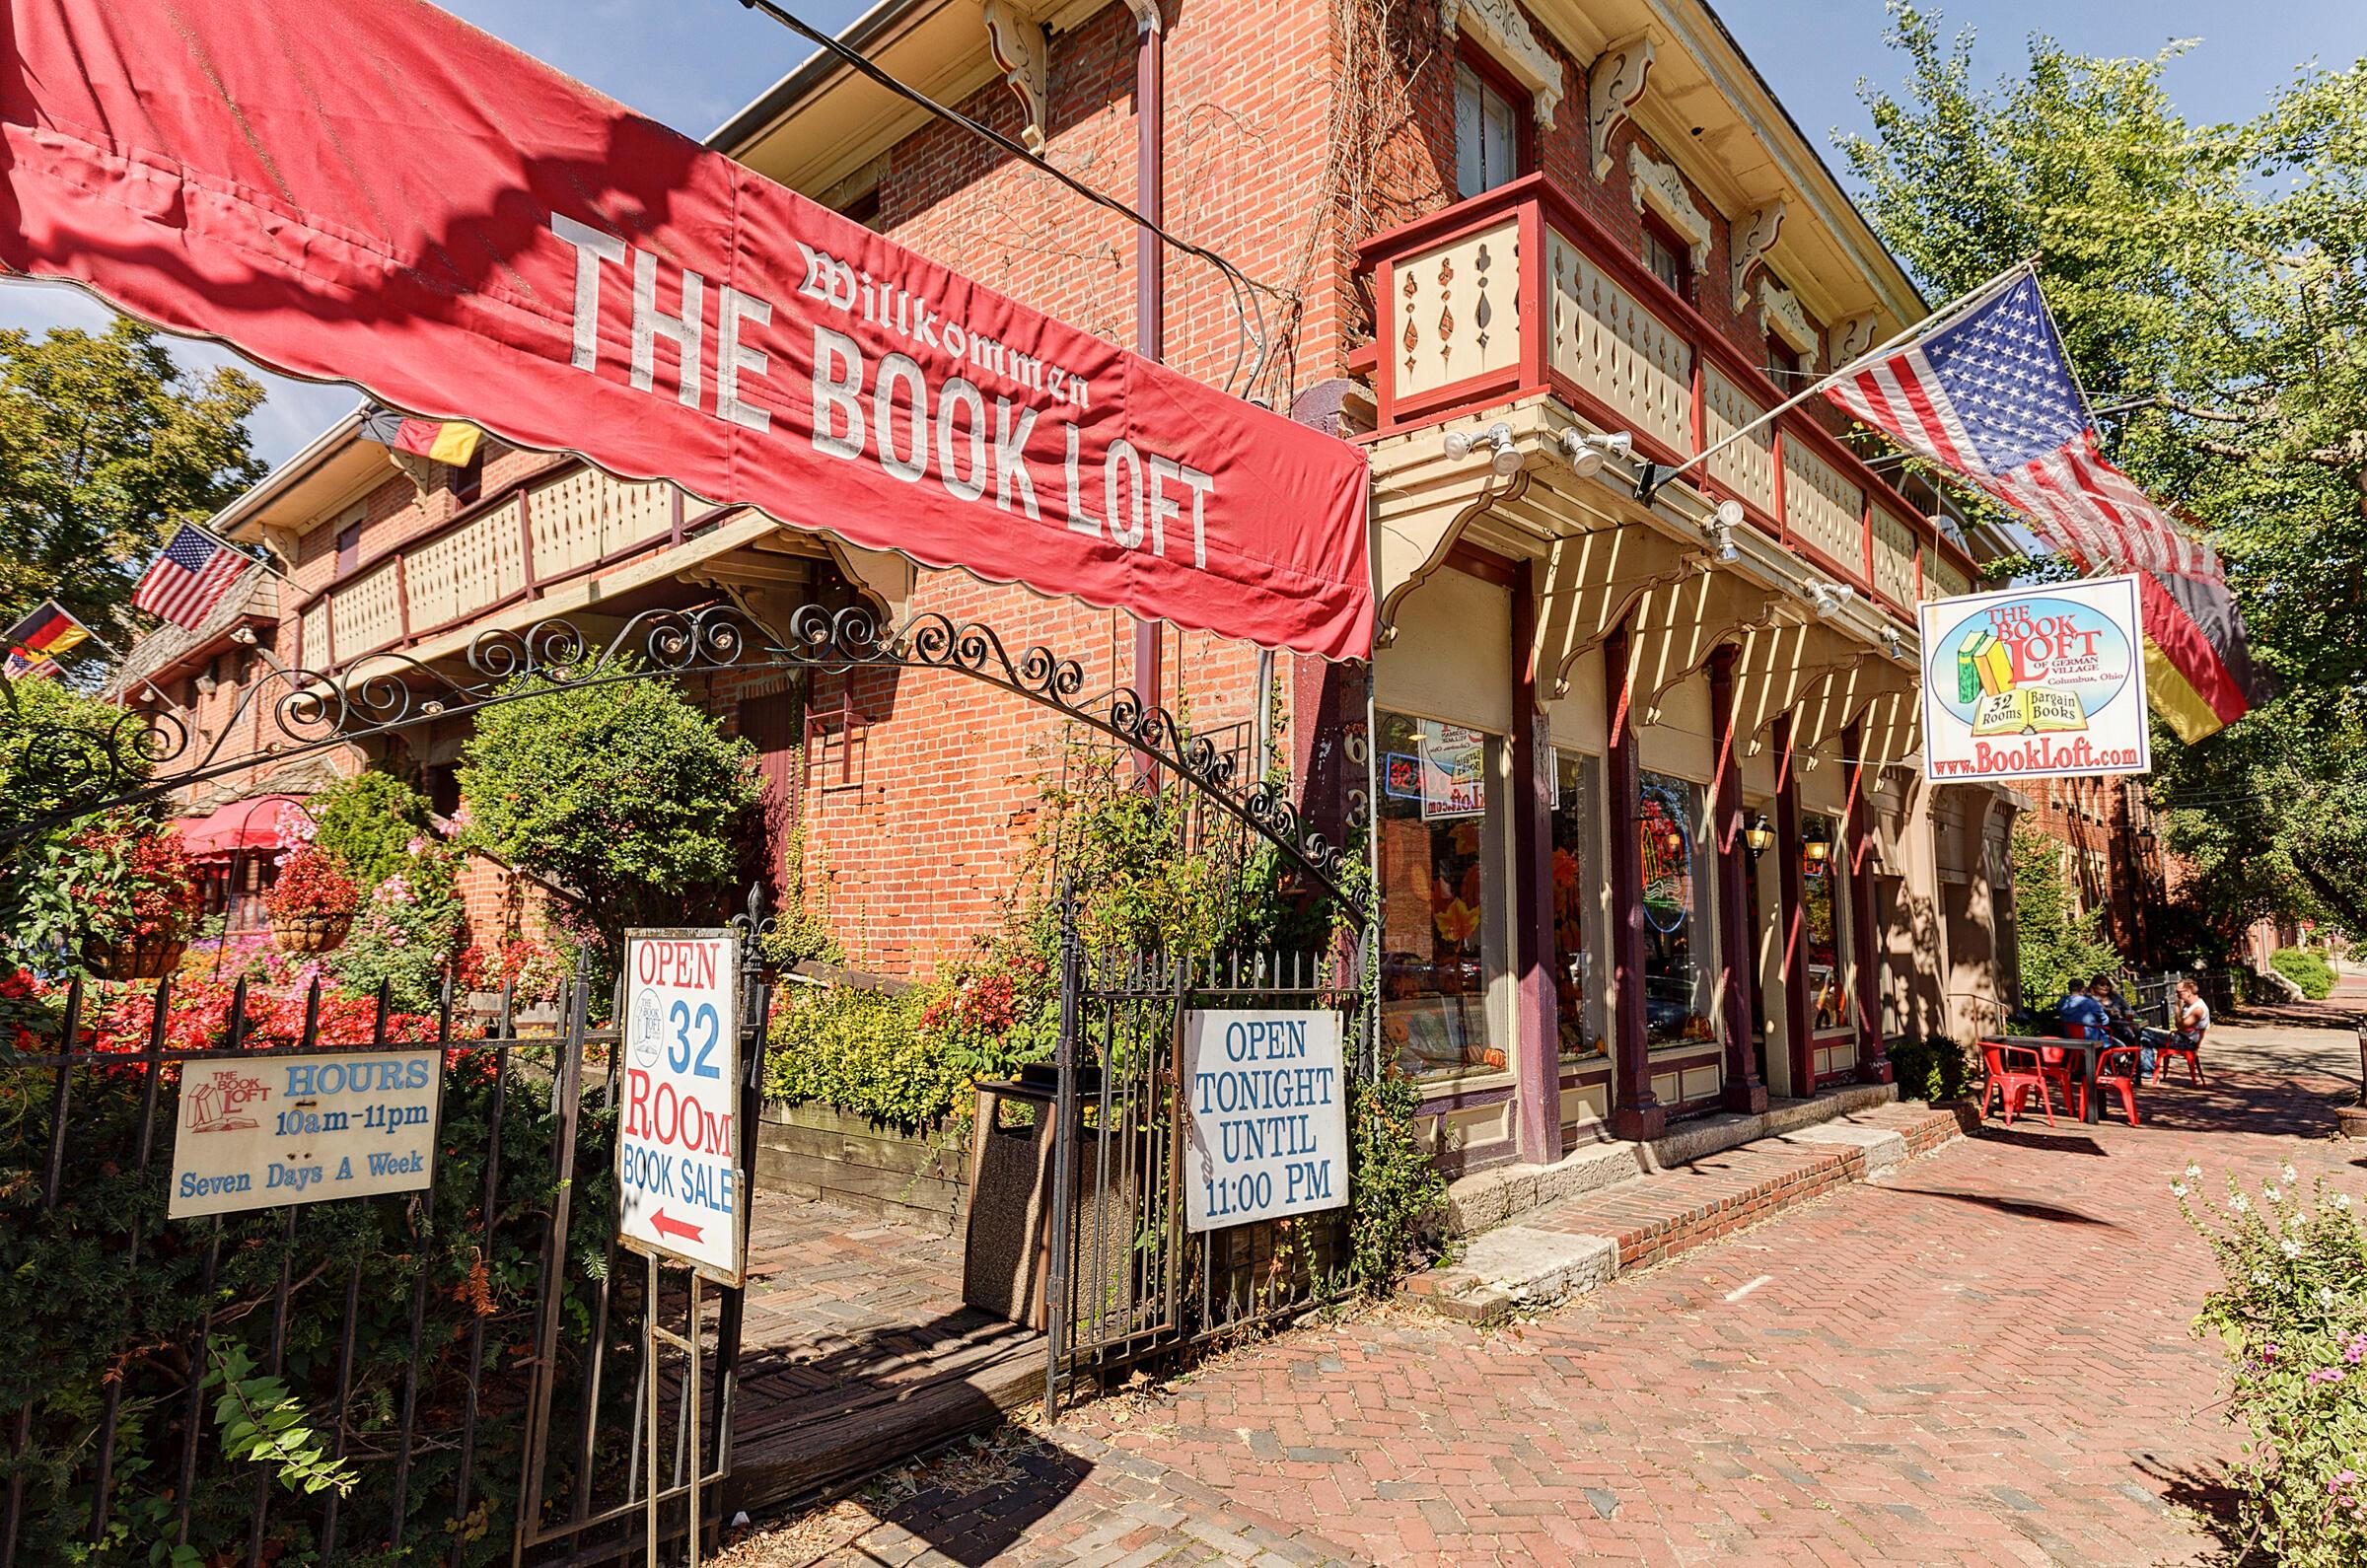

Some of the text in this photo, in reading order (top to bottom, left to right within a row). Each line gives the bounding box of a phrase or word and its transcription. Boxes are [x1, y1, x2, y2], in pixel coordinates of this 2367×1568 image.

[796, 241, 1091, 410] Willkommen
[550, 211, 1215, 570] THE BOOK LOFT
[1984, 605, 2031, 625] THE
[1995, 614, 2078, 642] BOOK
[2003, 630, 2103, 684] LOFT
[2034, 656, 2099, 670] OF GERMAN
[2052, 664, 2100, 676] VILLAGE
[2047, 673, 2124, 686] Columbus, Ohio
[1982, 708, 2023, 726] Rooms
[1990, 693, 2013, 713] 32
[2031, 690, 2076, 709] Bargain
[2033, 704, 2076, 721] Books
[1934, 736, 2139, 776] www.BookLoft.com
[1390, 762, 1411, 789] 32
[639, 940, 720, 990] OPEN
[668, 1000, 721, 1080] 32
[1226, 1020, 1307, 1062] OPEN
[212, 1070, 238, 1081] THE
[217, 1078, 260, 1091] BOOK
[283, 1059, 430, 1098] HOURS
[1195, 1067, 1334, 1114] TONIGHT
[223, 1087, 272, 1113] LOFT
[625, 1068, 732, 1158] ROOM
[275, 1103, 429, 1136] 10am-11pm
[1219, 1114, 1317, 1164] UNTIL
[179, 1150, 424, 1199] Seven Days A Week
[623, 1143, 733, 1214] BOOK SALE
[1206, 1159, 1332, 1218] 11:00 PM
